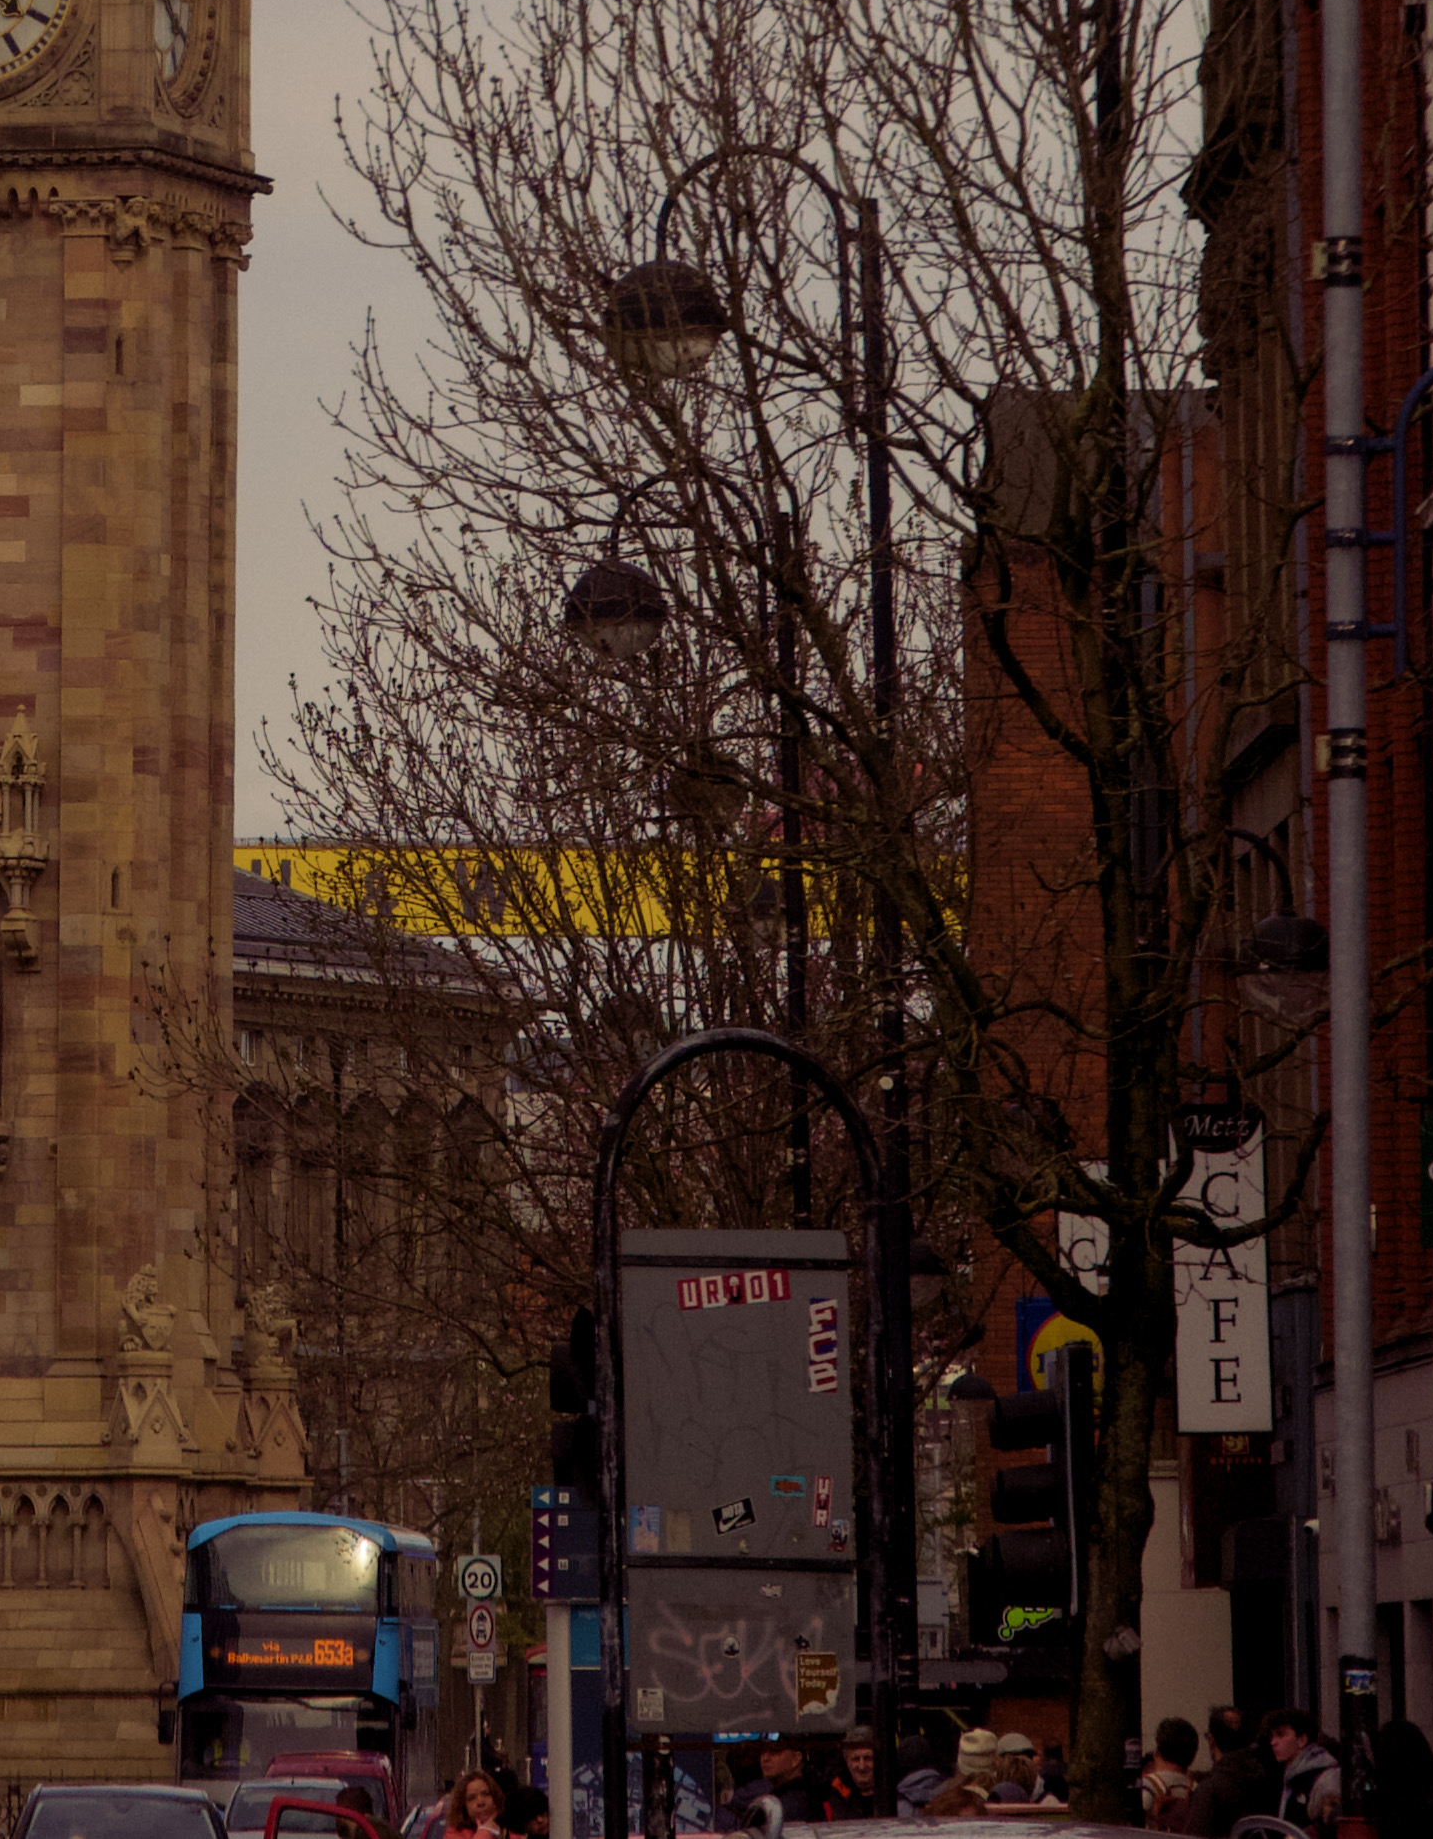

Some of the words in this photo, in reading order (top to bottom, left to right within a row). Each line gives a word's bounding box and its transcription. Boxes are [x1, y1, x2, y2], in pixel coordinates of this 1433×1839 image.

[1199, 1171, 1242, 1403] CAFE
[467, 1572, 493, 1589] 20
[262, 1640, 281, 1652] via
[313, 1638, 354, 1666] 653a
